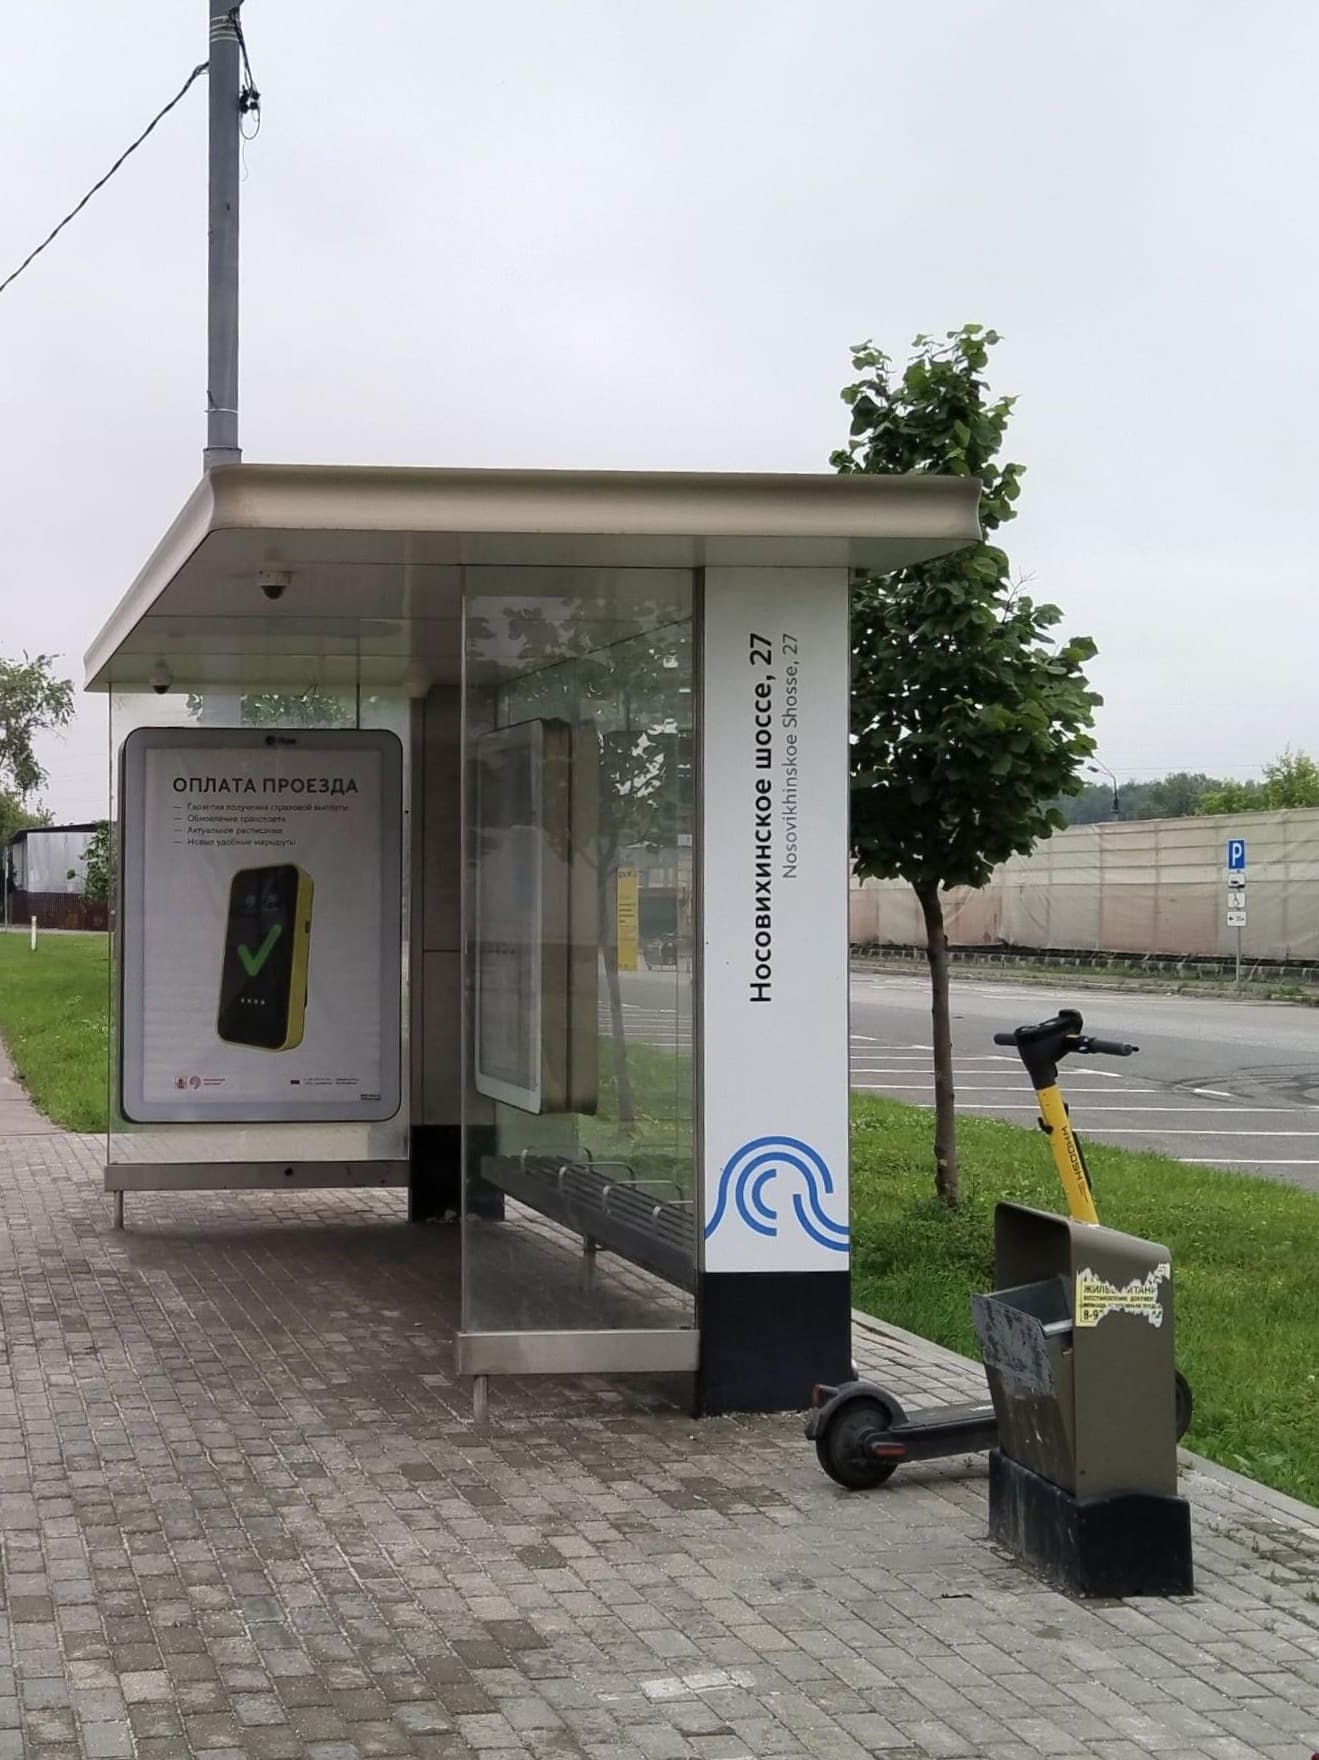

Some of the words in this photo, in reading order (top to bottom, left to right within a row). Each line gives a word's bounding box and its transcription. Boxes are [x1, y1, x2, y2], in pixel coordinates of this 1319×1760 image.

[749, 632, 772, 665] 27
[782, 633, 798, 655] 27
[755, 674, 776, 769] шоссе,
[781, 660, 800, 728] Shosse,
[172, 776, 257, 793] ОПЛАТА
[262, 777, 359, 795] ПРОЕЗДА
[781, 734, 798, 879] Nosovikhinskoe
[1232, 842, 1242, 867] P
[749, 778, 772, 1002] Носовихинское
[1061, 1125, 1083, 1181] WHOOSH
